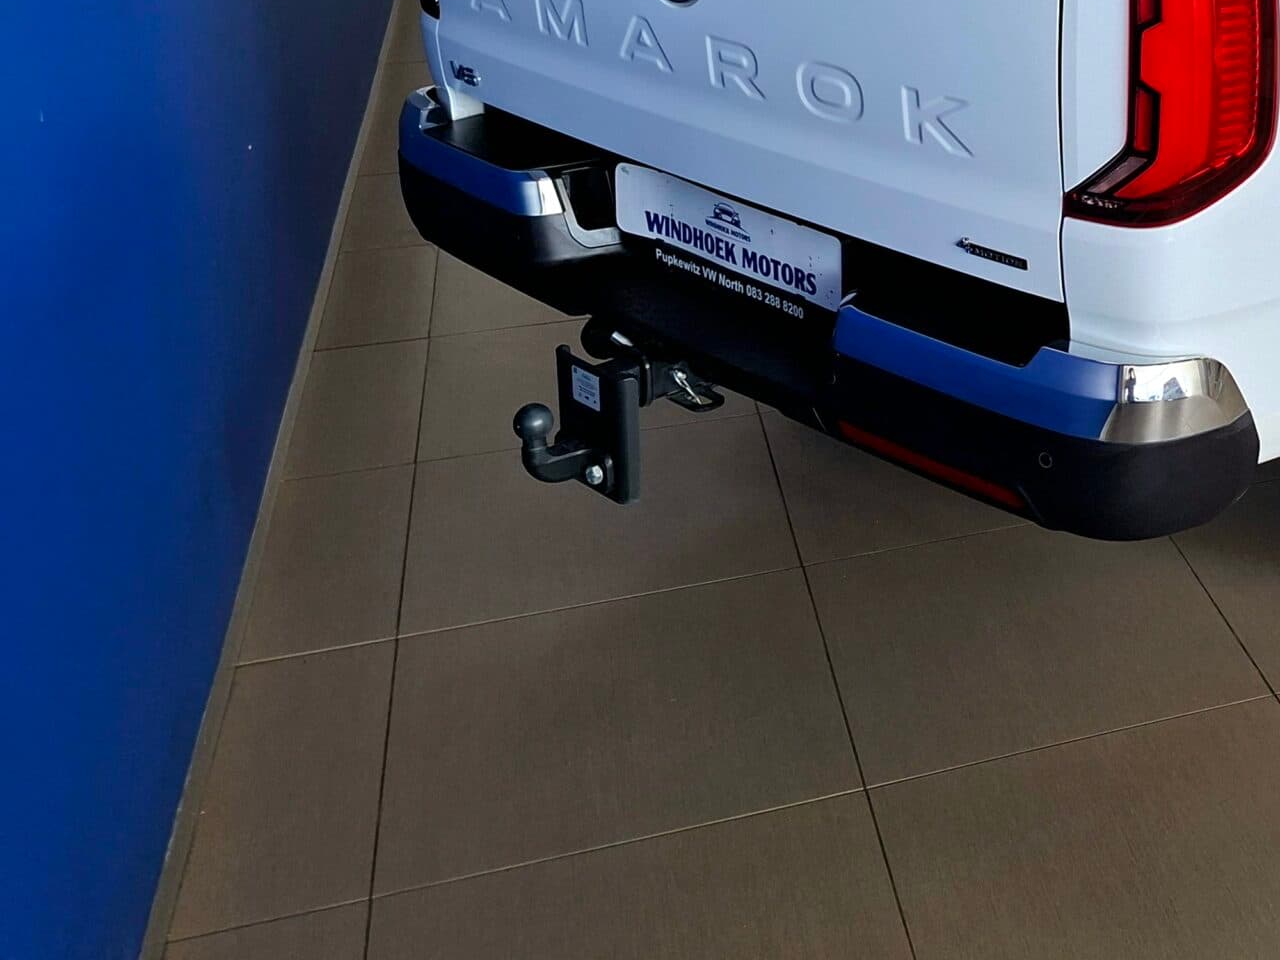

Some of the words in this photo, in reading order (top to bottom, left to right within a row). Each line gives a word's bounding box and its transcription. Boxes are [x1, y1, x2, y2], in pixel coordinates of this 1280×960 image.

[645, 210, 737, 265] WINDHOEK
[742, 247, 817, 295] MOTORS
[656, 248, 701, 275] Pupkewitz
[702, 266, 717, 283] VW
[719, 273, 744, 294] North
